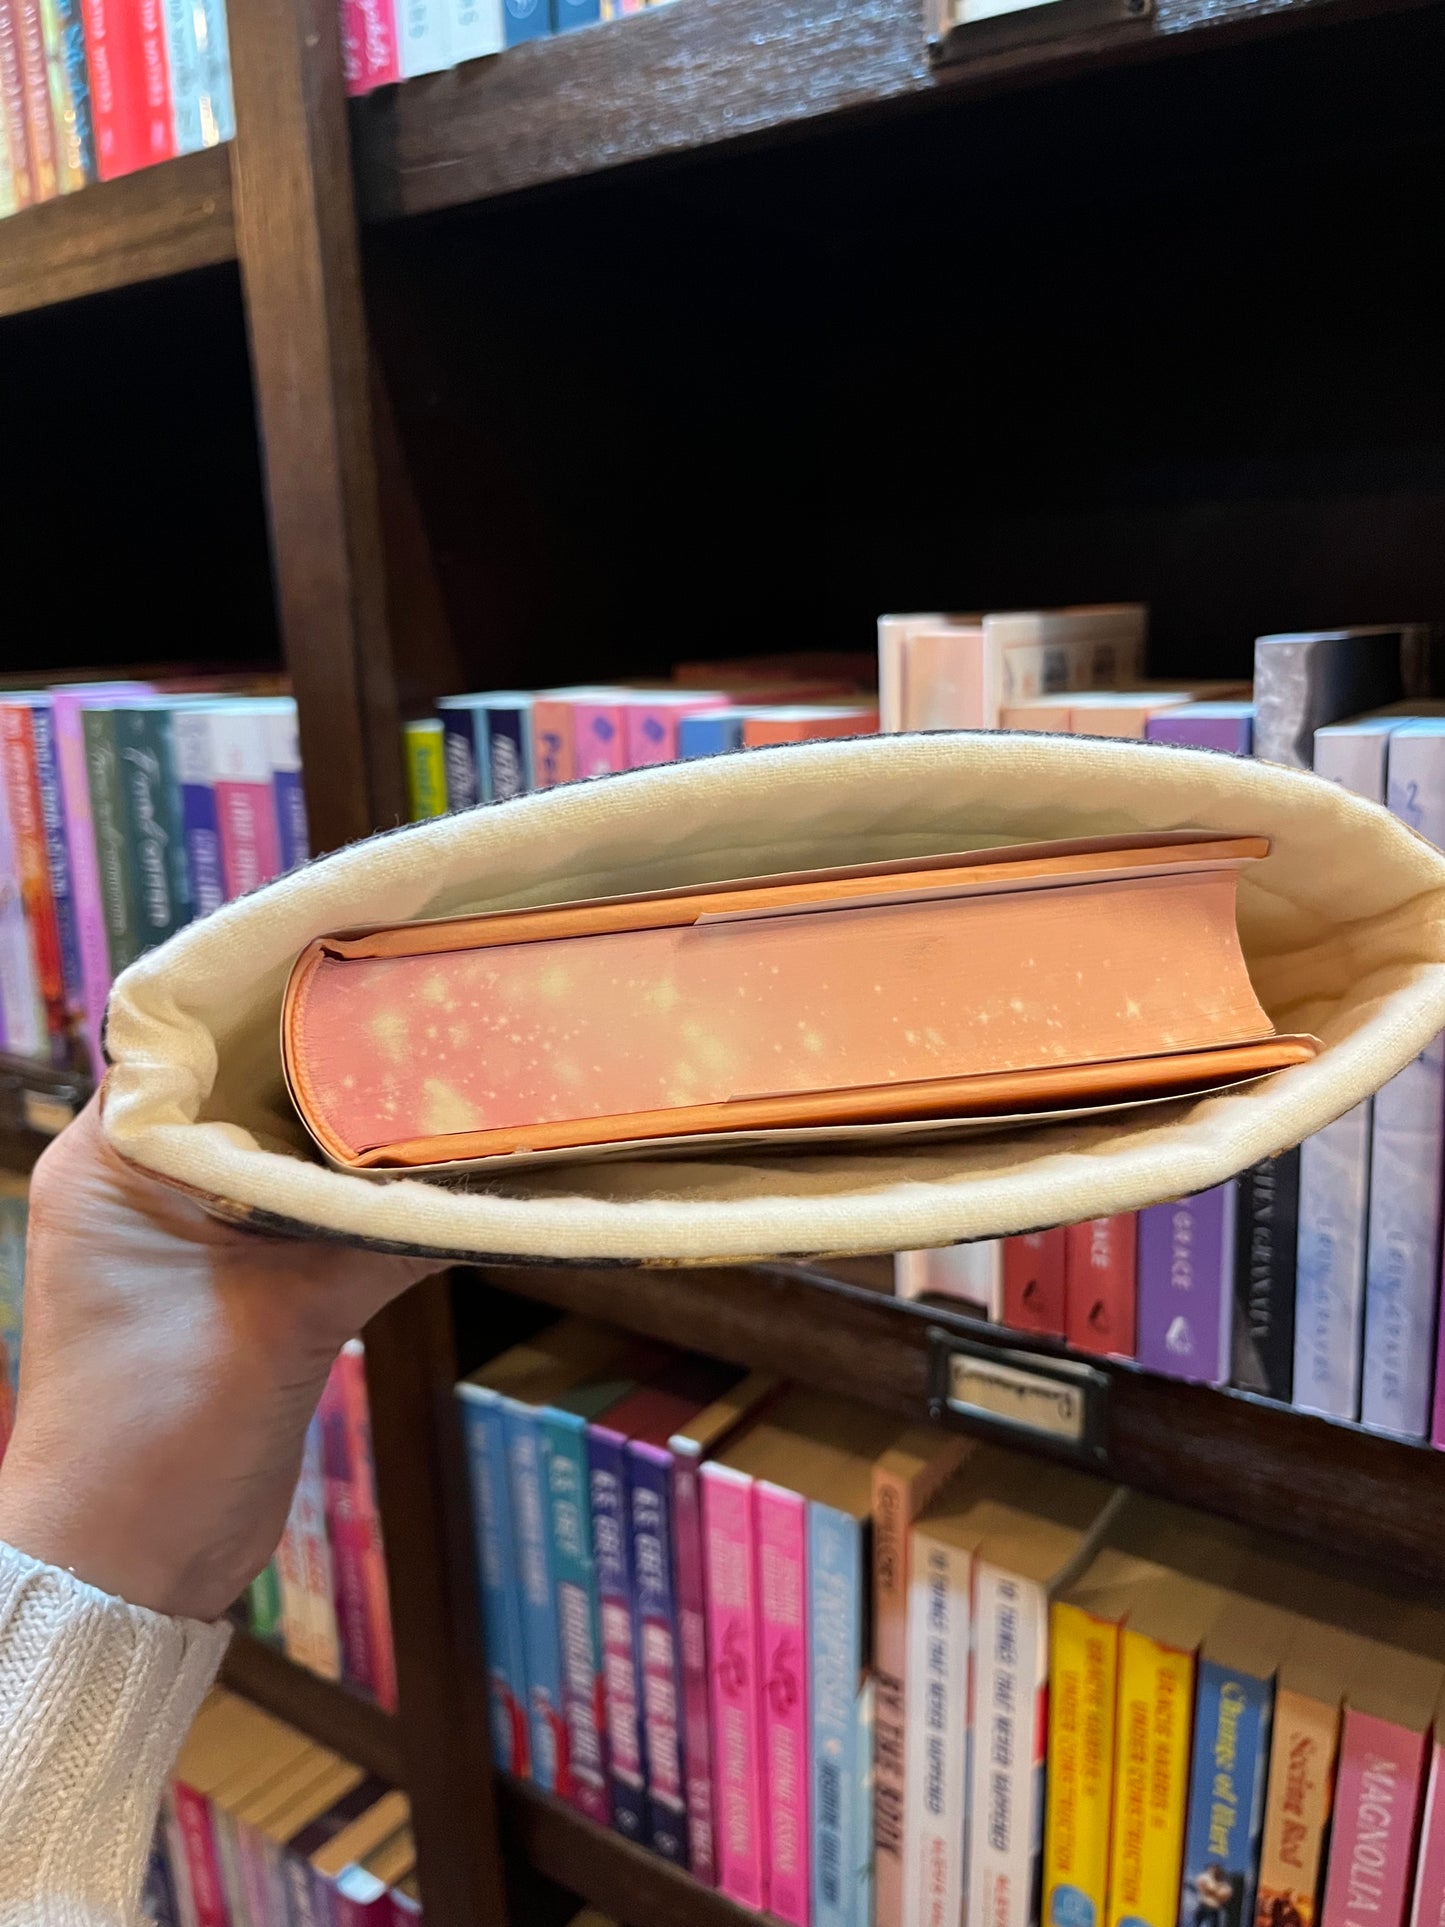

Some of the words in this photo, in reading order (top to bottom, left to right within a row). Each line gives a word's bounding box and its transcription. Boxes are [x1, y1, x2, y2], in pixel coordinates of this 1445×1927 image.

[1171, 1211, 1193, 1291] GRACE
[875, 1673, 905, 1717] BY
[1211, 1681, 1249, 1771] Change
[876, 1784, 905, 1862] BOOK
[1212, 1772, 1238, 1803] of
[1344, 1753, 1399, 1912] MAGNOLIA
